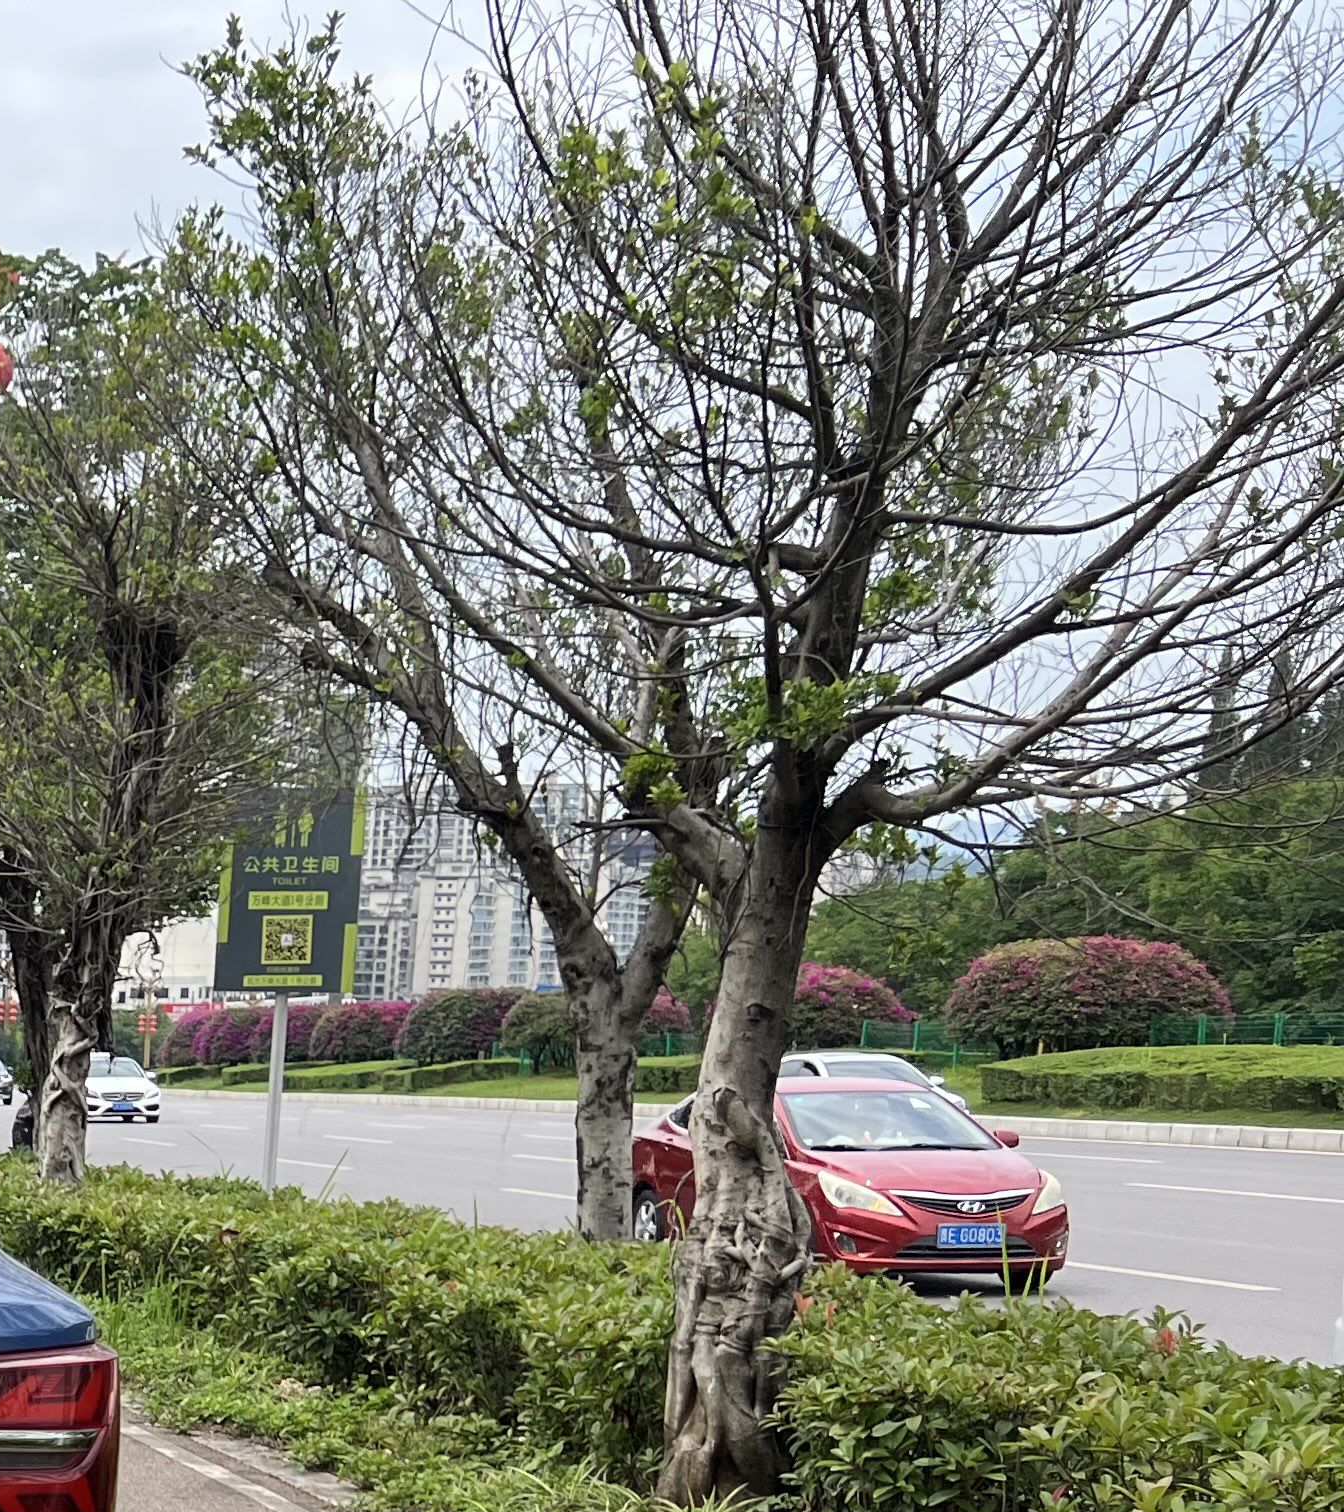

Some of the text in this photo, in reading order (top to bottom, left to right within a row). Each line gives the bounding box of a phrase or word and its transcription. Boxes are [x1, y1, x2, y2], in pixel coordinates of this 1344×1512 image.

[242, 855, 341, 875] 公共卫生间
[271, 876, 308, 886] TOILET
